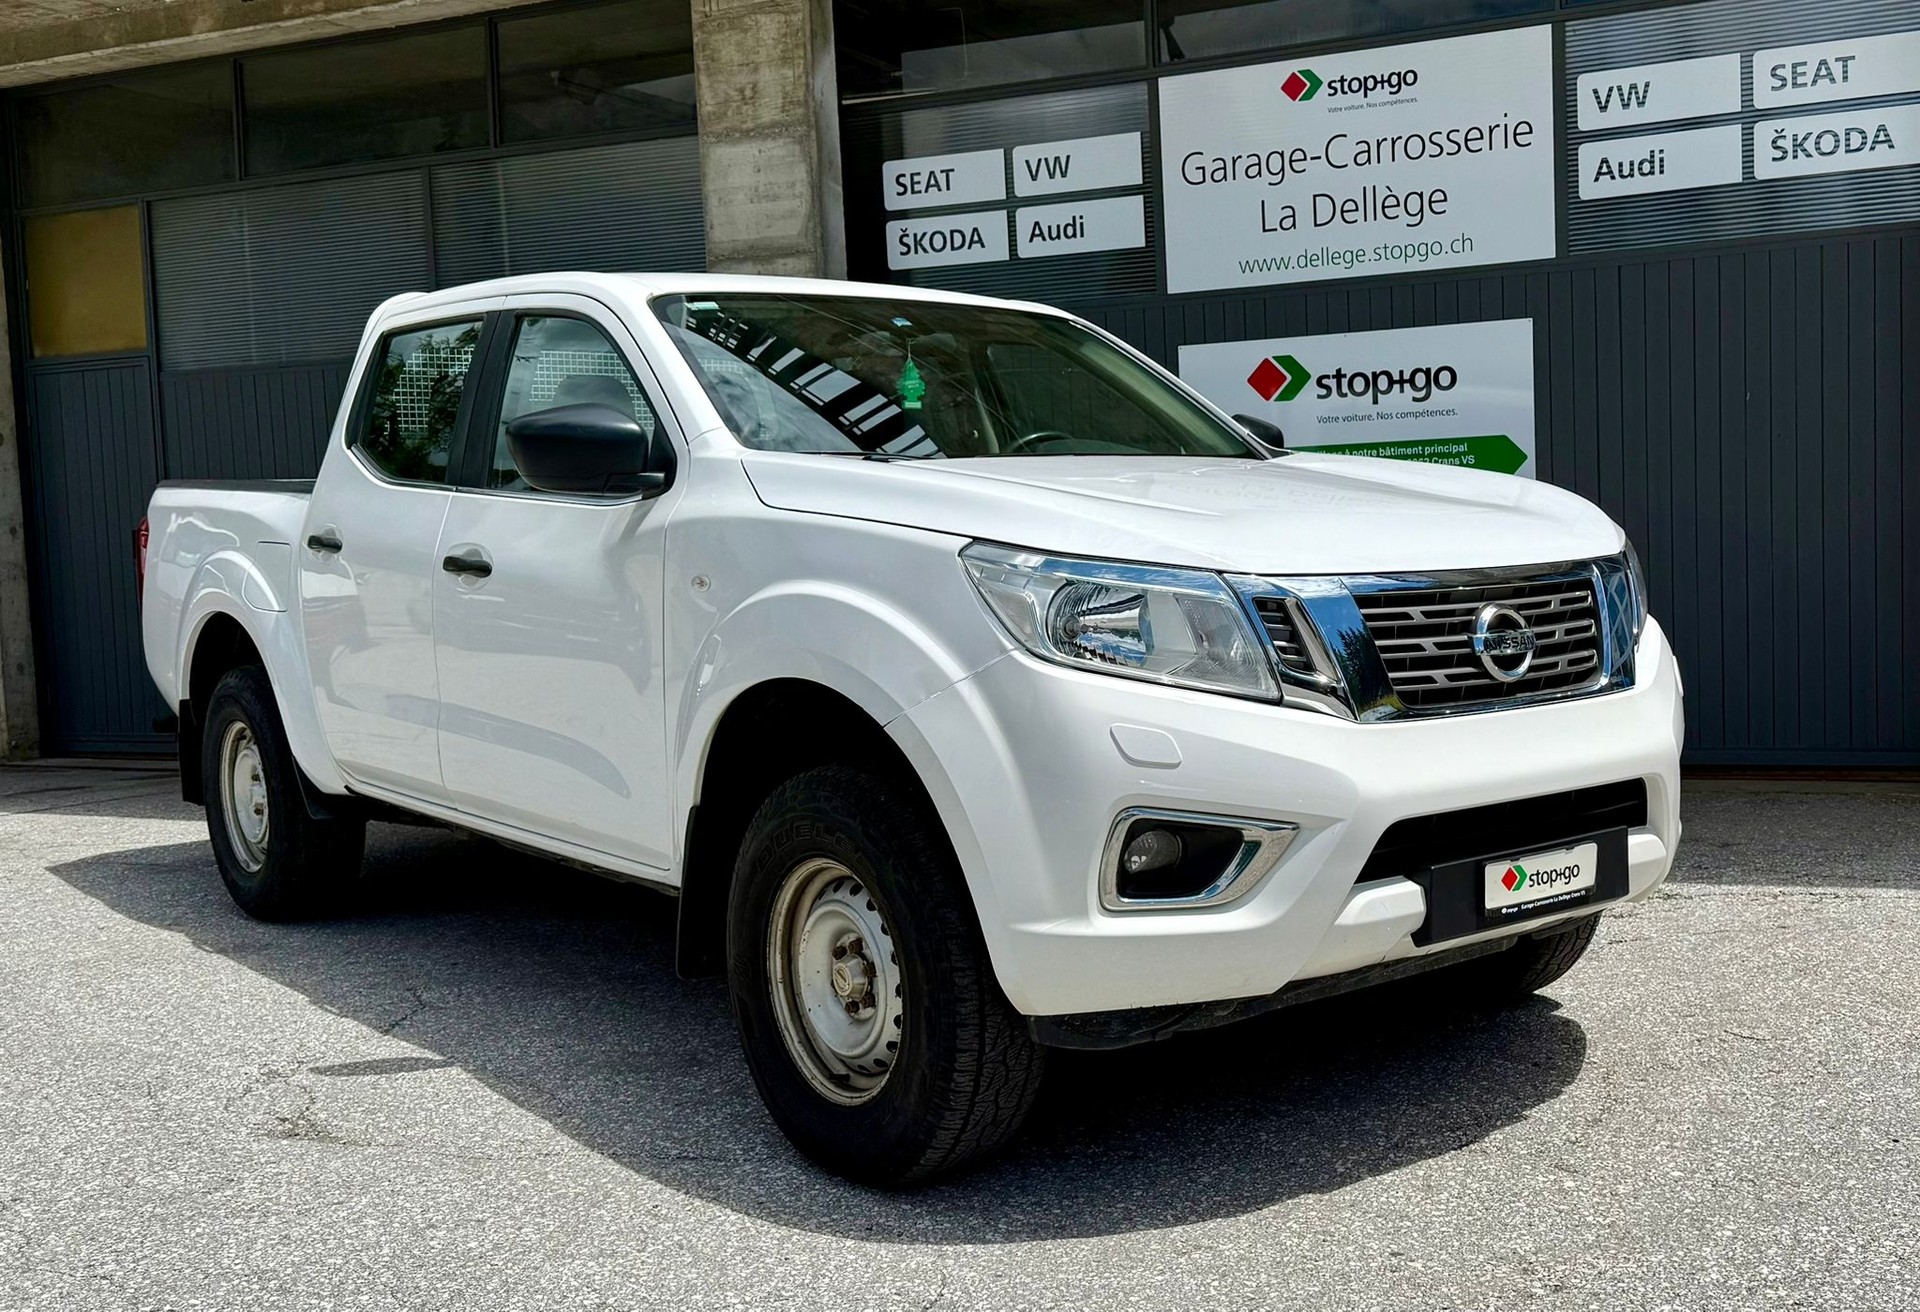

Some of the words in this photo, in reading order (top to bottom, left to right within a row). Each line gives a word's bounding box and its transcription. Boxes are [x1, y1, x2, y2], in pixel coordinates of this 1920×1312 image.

[1327, 69, 1418, 98] stop+go
[1769, 55, 1856, 92] SEAT
[1592, 81, 1651, 114] VW
[1181, 112, 1534, 186] Garage-Carrosserie
[1770, 124, 1896, 163] ŠKODA
[1024, 154, 1071, 182] VW
[1592, 149, 1665, 183] Audi
[895, 168, 955, 197] SEAT
[1260, 199, 1297, 233] La
[1312, 184, 1448, 227] Dellège
[898, 227, 986, 257] ŠKODA
[1028, 215, 1085, 243] Audi
[1238, 232, 1473, 274] www.dellege.stopgo.ch
[1315, 365, 1457, 405] stop+go
[1316, 415, 1340, 424] Votre
[1341, 412, 1375, 423] voiture.
[1376, 411, 1393, 420] Nos
[1395, 408, 1458, 420] compétences.
[1352, 449, 1377, 457] notre
[1379, 446, 1423, 457] bâtiment
[1424, 442, 1468, 456] principal
[1461, 455, 1475, 465] VS
[1529, 864, 1580, 888] stop+go
